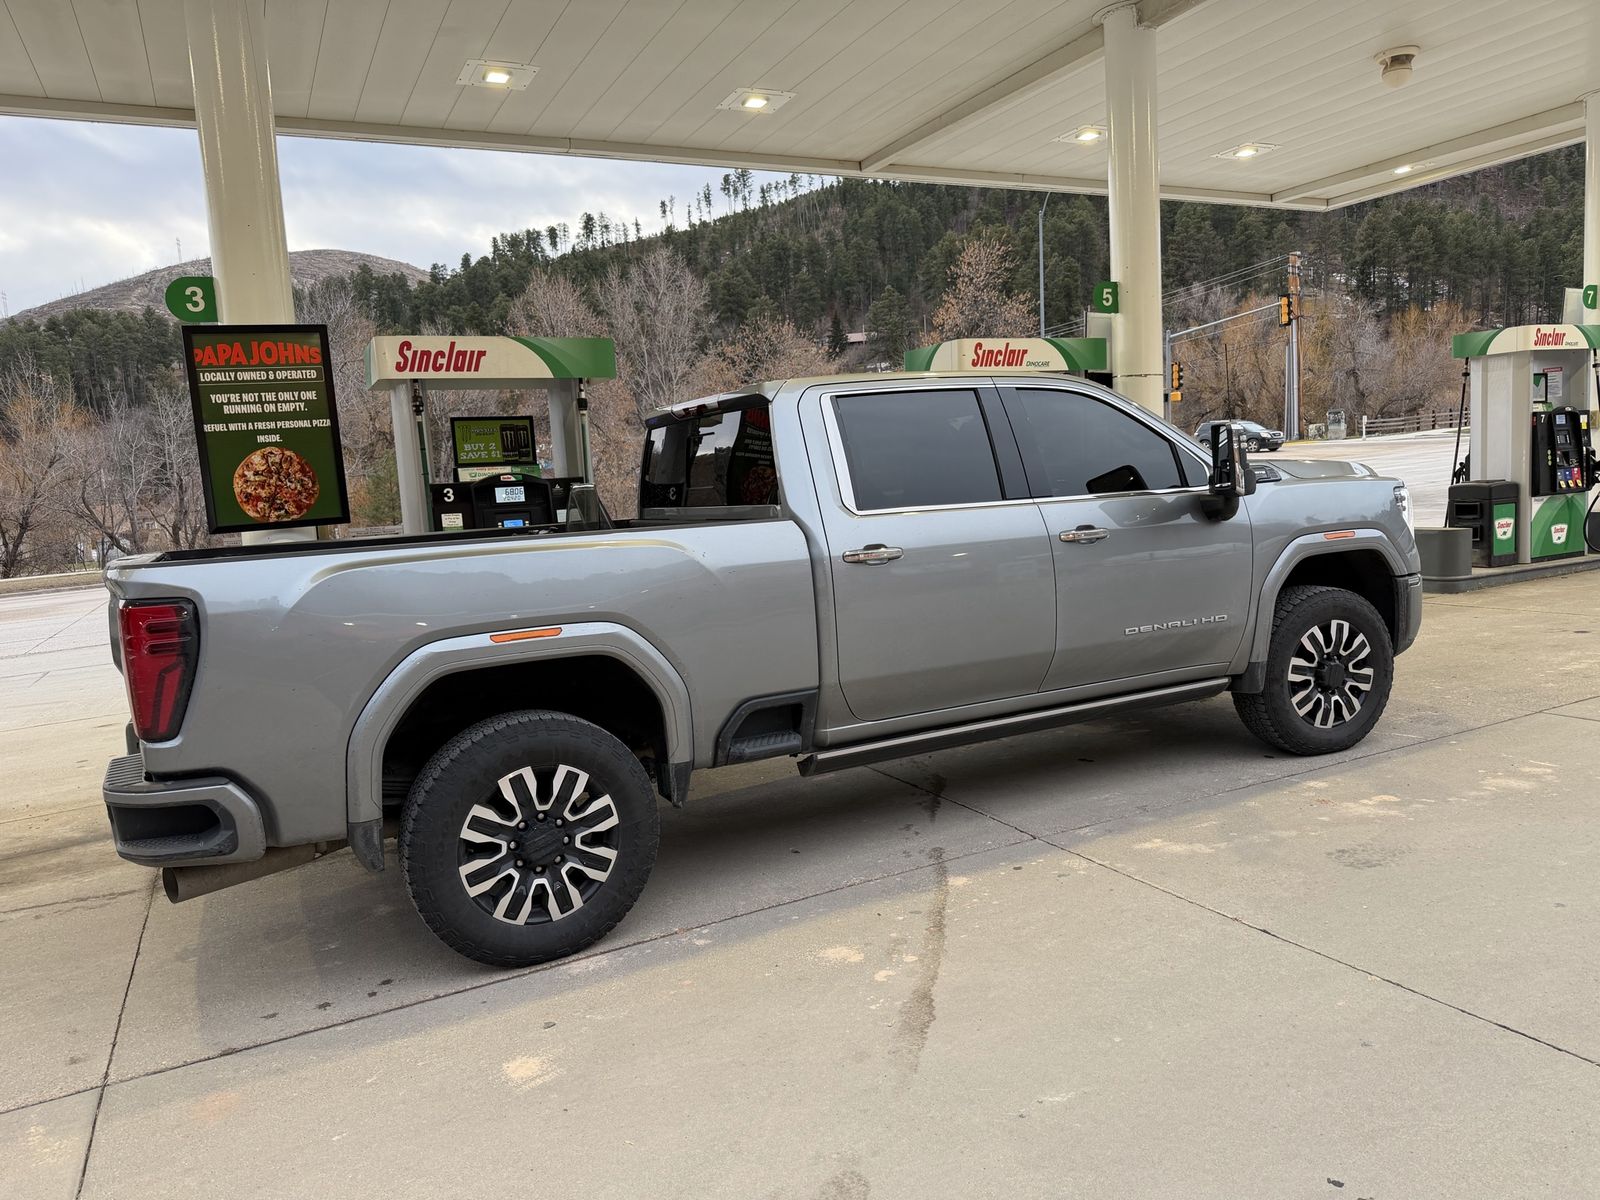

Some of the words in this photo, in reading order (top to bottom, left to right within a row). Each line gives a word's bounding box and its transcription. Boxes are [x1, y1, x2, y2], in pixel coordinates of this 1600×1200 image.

[185, 286, 206, 313] 3
[1102, 288, 1113, 306] 5
[1587, 291, 1594, 305] 7
[1534, 327, 1566, 346] Sinclair
[194, 342, 248, 366] PAPA
[249, 340, 321, 366] JOHNS
[395, 340, 487, 373] Sinclair
[971, 342, 1028, 367] Sinclair
[200, 372, 235, 382] LOCALLY
[236, 371, 267, 380] OWNED
[276, 370, 317, 379] OPERATED
[210, 393, 240, 403] YOU'RE
[242, 393, 259, 402] NOT
[260, 392, 276, 402] THE
[278, 391, 299, 401] ONLY
[300, 390, 317, 400] ONE
[223, 404, 262, 414] RUNNING
[264, 404, 276, 413] ON
[278, 402, 308, 412] EMPTY.
[203, 423, 228, 432] REFUEL
[228, 422, 247, 431] WITH
[248, 422, 255, 430] A
[254, 421, 276, 430] FRESH
[277, 420, 312, 429] PERSONAL
[312, 418, 331, 427] PIZZA
[1540, 414, 1546, 423] 7
[257, 434, 283, 443] INSIDE.
[443, 487, 455, 502] 3
[1125, 618, 1197, 635] DENALI
[1202, 614, 1228, 624] HD
